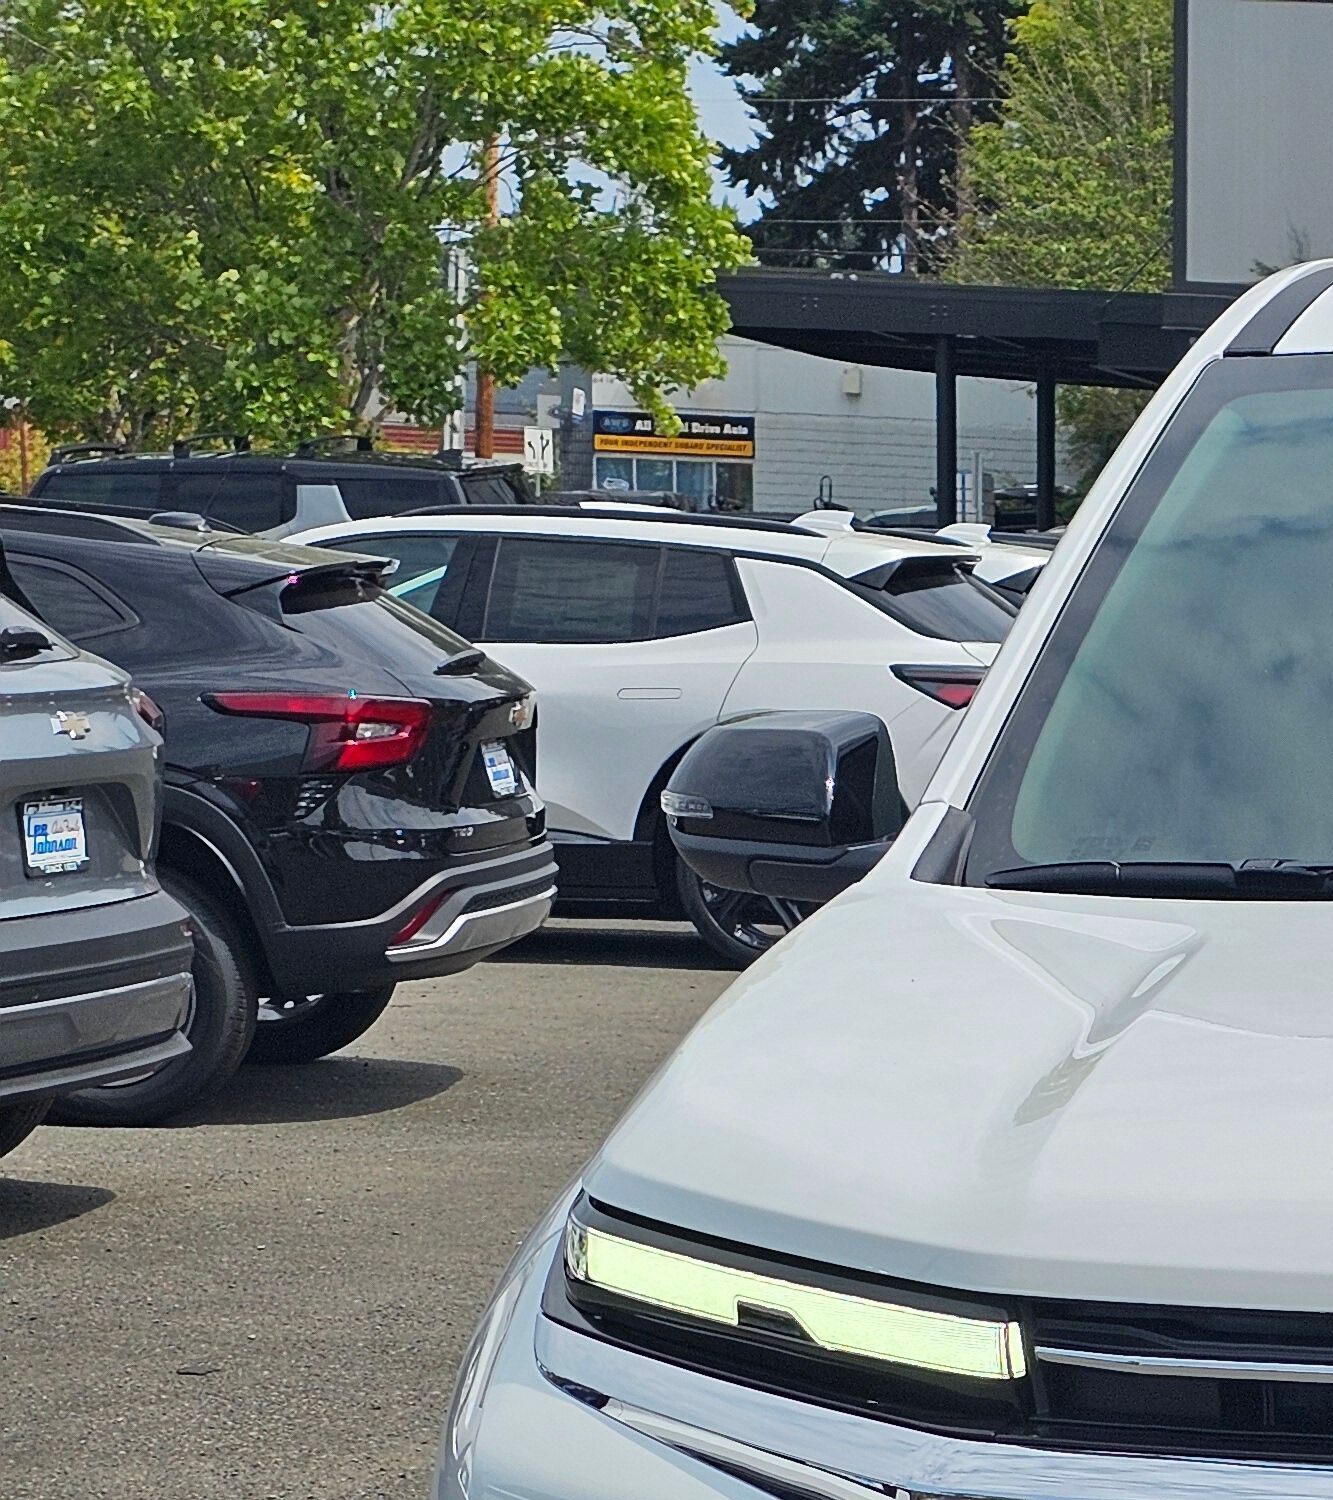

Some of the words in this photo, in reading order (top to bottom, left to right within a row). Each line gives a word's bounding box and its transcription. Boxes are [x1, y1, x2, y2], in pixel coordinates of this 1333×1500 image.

[723, 423, 749, 435] Auto
[621, 440, 673, 449] INDEPENDENT
[706, 443, 748, 452] SPECIALIST
